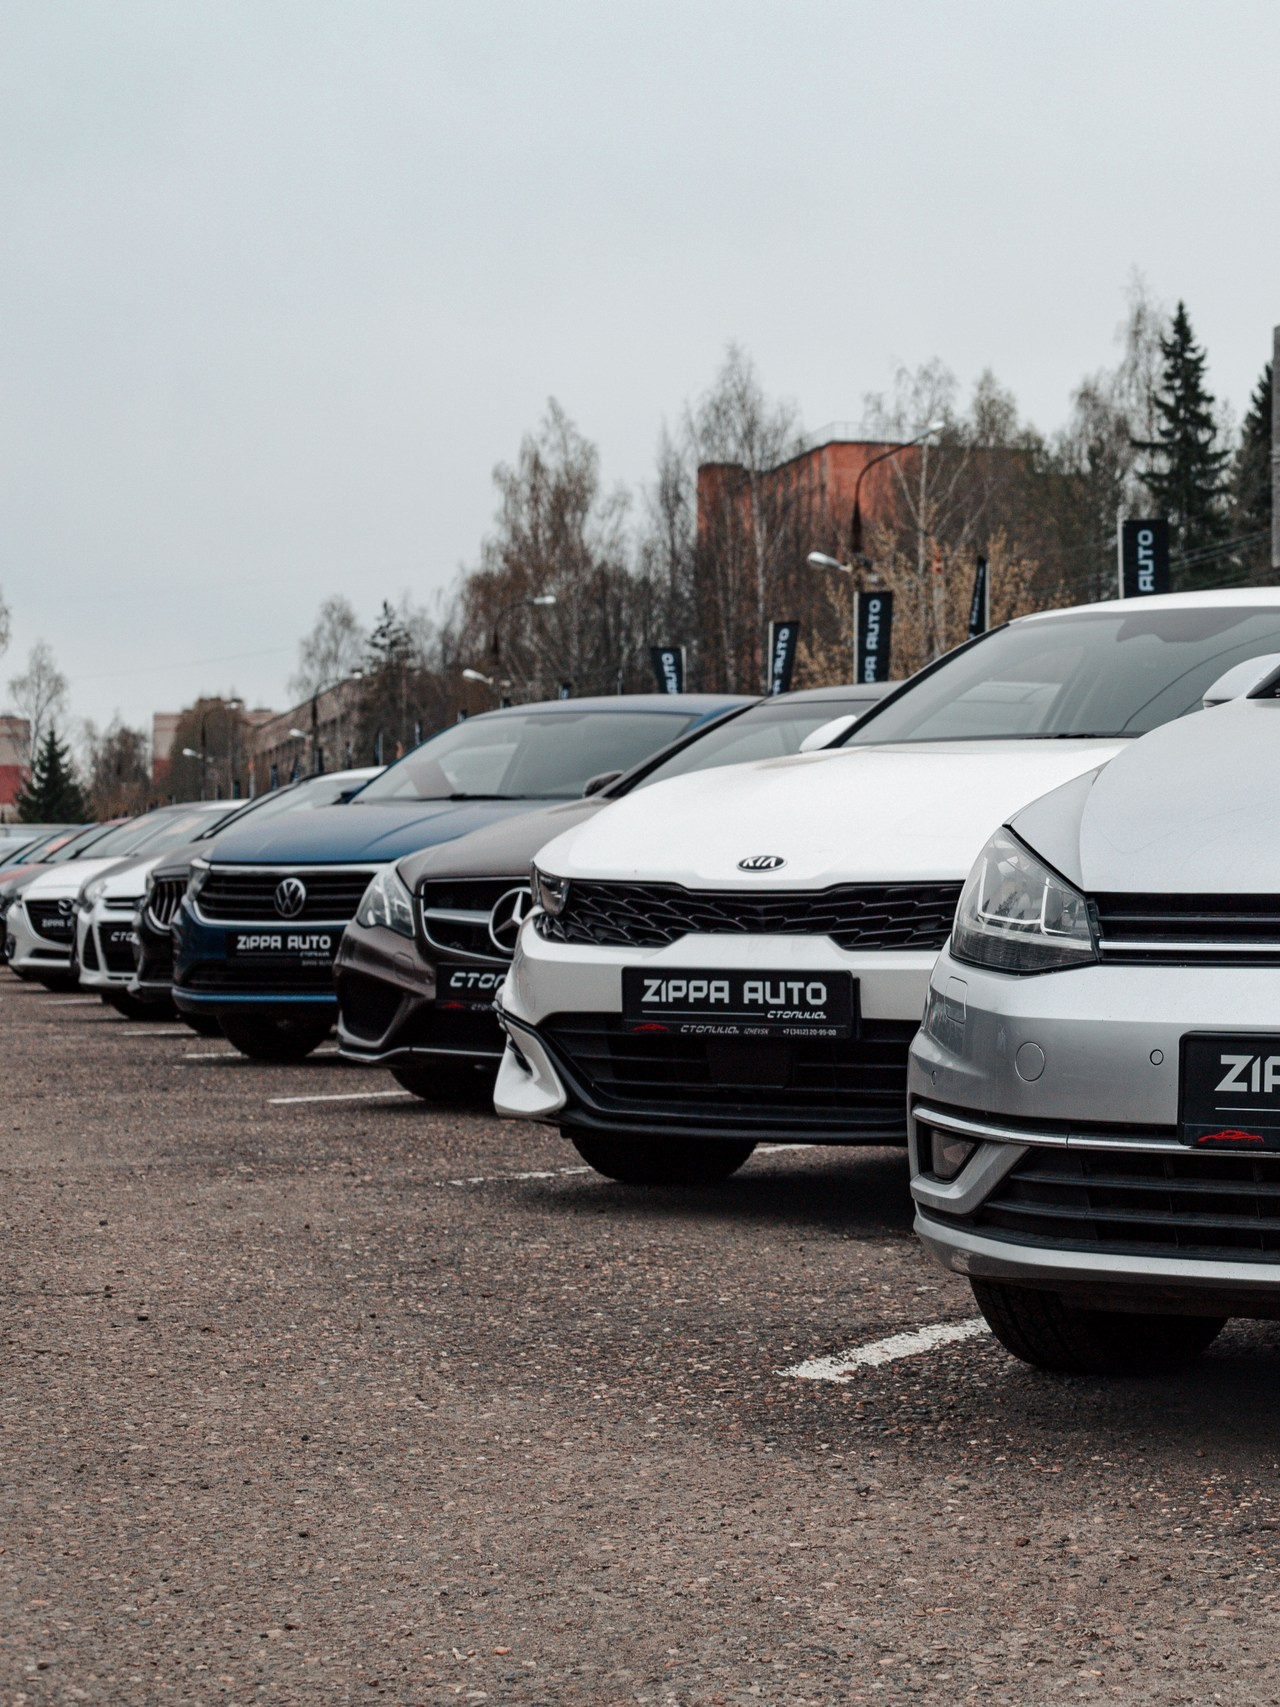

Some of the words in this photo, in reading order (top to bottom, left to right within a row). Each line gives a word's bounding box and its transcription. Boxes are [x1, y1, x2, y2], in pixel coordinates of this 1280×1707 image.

[1137, 529, 1155, 592] AUTO
[865, 599, 882, 651] AUTO
[742, 856, 777, 867] KIA
[236, 935, 282, 950] ZIPPA
[287, 935, 332, 950] AUTO
[641, 978, 730, 1004] ZIPPA
[743, 980, 827, 1006] AUTO
